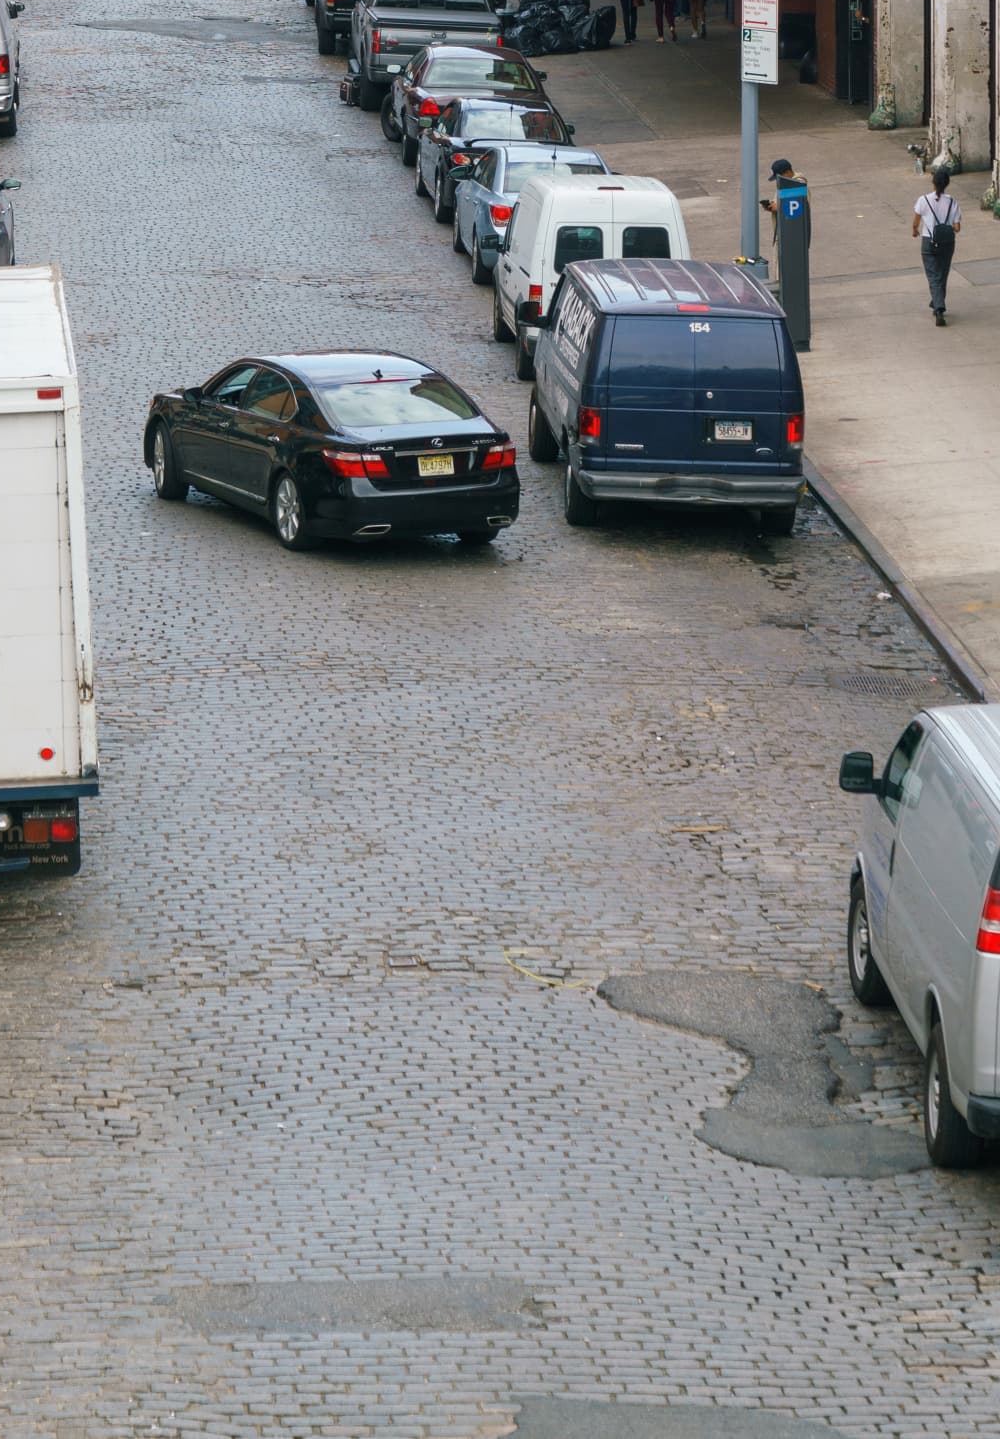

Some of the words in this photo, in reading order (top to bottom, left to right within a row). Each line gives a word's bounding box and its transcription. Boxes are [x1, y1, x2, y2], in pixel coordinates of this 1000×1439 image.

[744, 30, 750, 40] 2
[689, 322, 711, 333] 154
[32, 856, 50, 864] New
[51, 854, 69, 864] York
